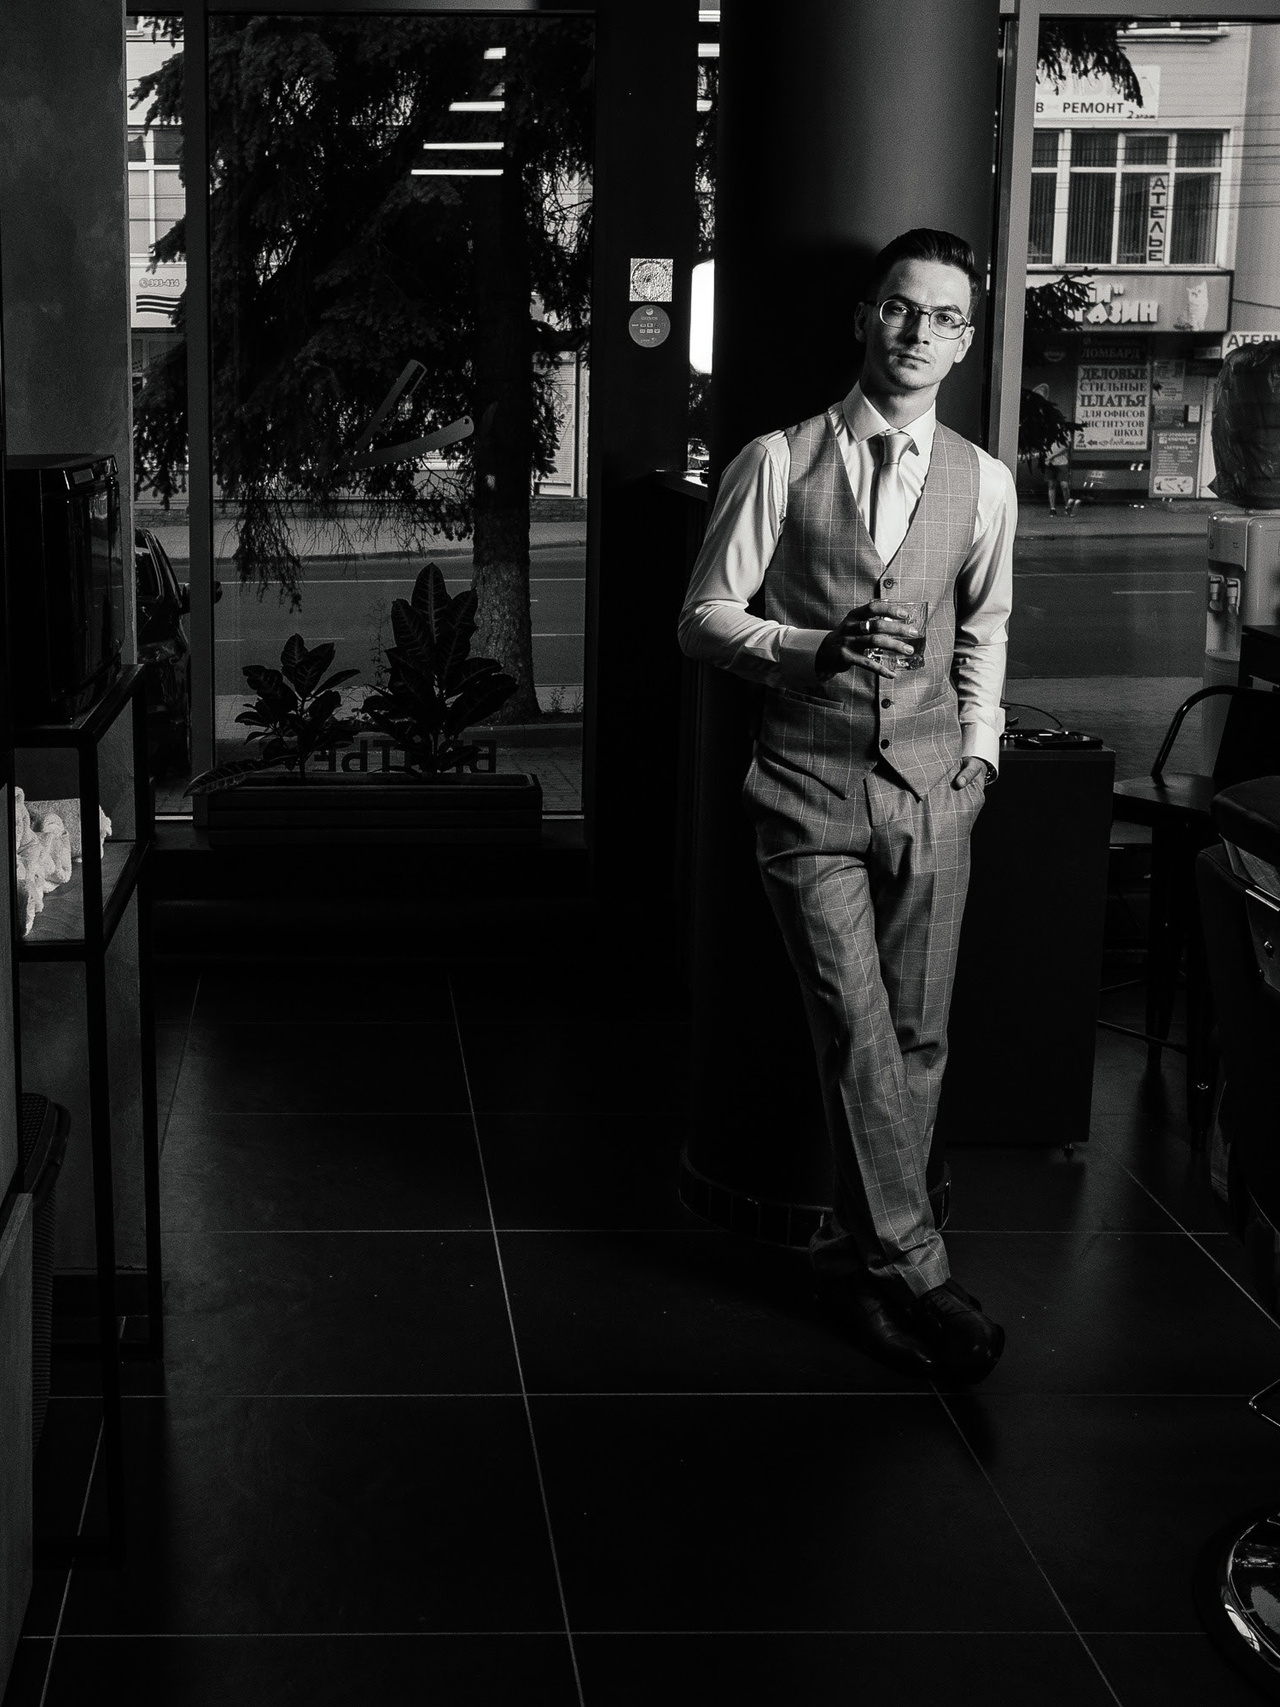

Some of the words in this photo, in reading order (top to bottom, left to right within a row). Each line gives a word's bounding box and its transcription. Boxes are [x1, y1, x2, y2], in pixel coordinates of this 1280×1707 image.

[1062, 102, 1125, 113] РЕМОНТ
[1148, 177, 1166, 262] АТЕЛЬЕ
[1081, 348, 1141, 360] ЛОМБАРД
[1080, 368, 1148, 381] ДЕЛОВЫЕ
[1080, 382, 1147, 392] СТИЛЬНЫЕ
[1079, 394, 1147, 407] ПЛАТЬЯ
[1081, 410, 1101, 418] ДЛЯ
[1103, 410, 1145, 418] ОФИСОВ
[1077, 433, 1085, 444] 2
[1114, 429, 1144, 437] ШКОЛ
